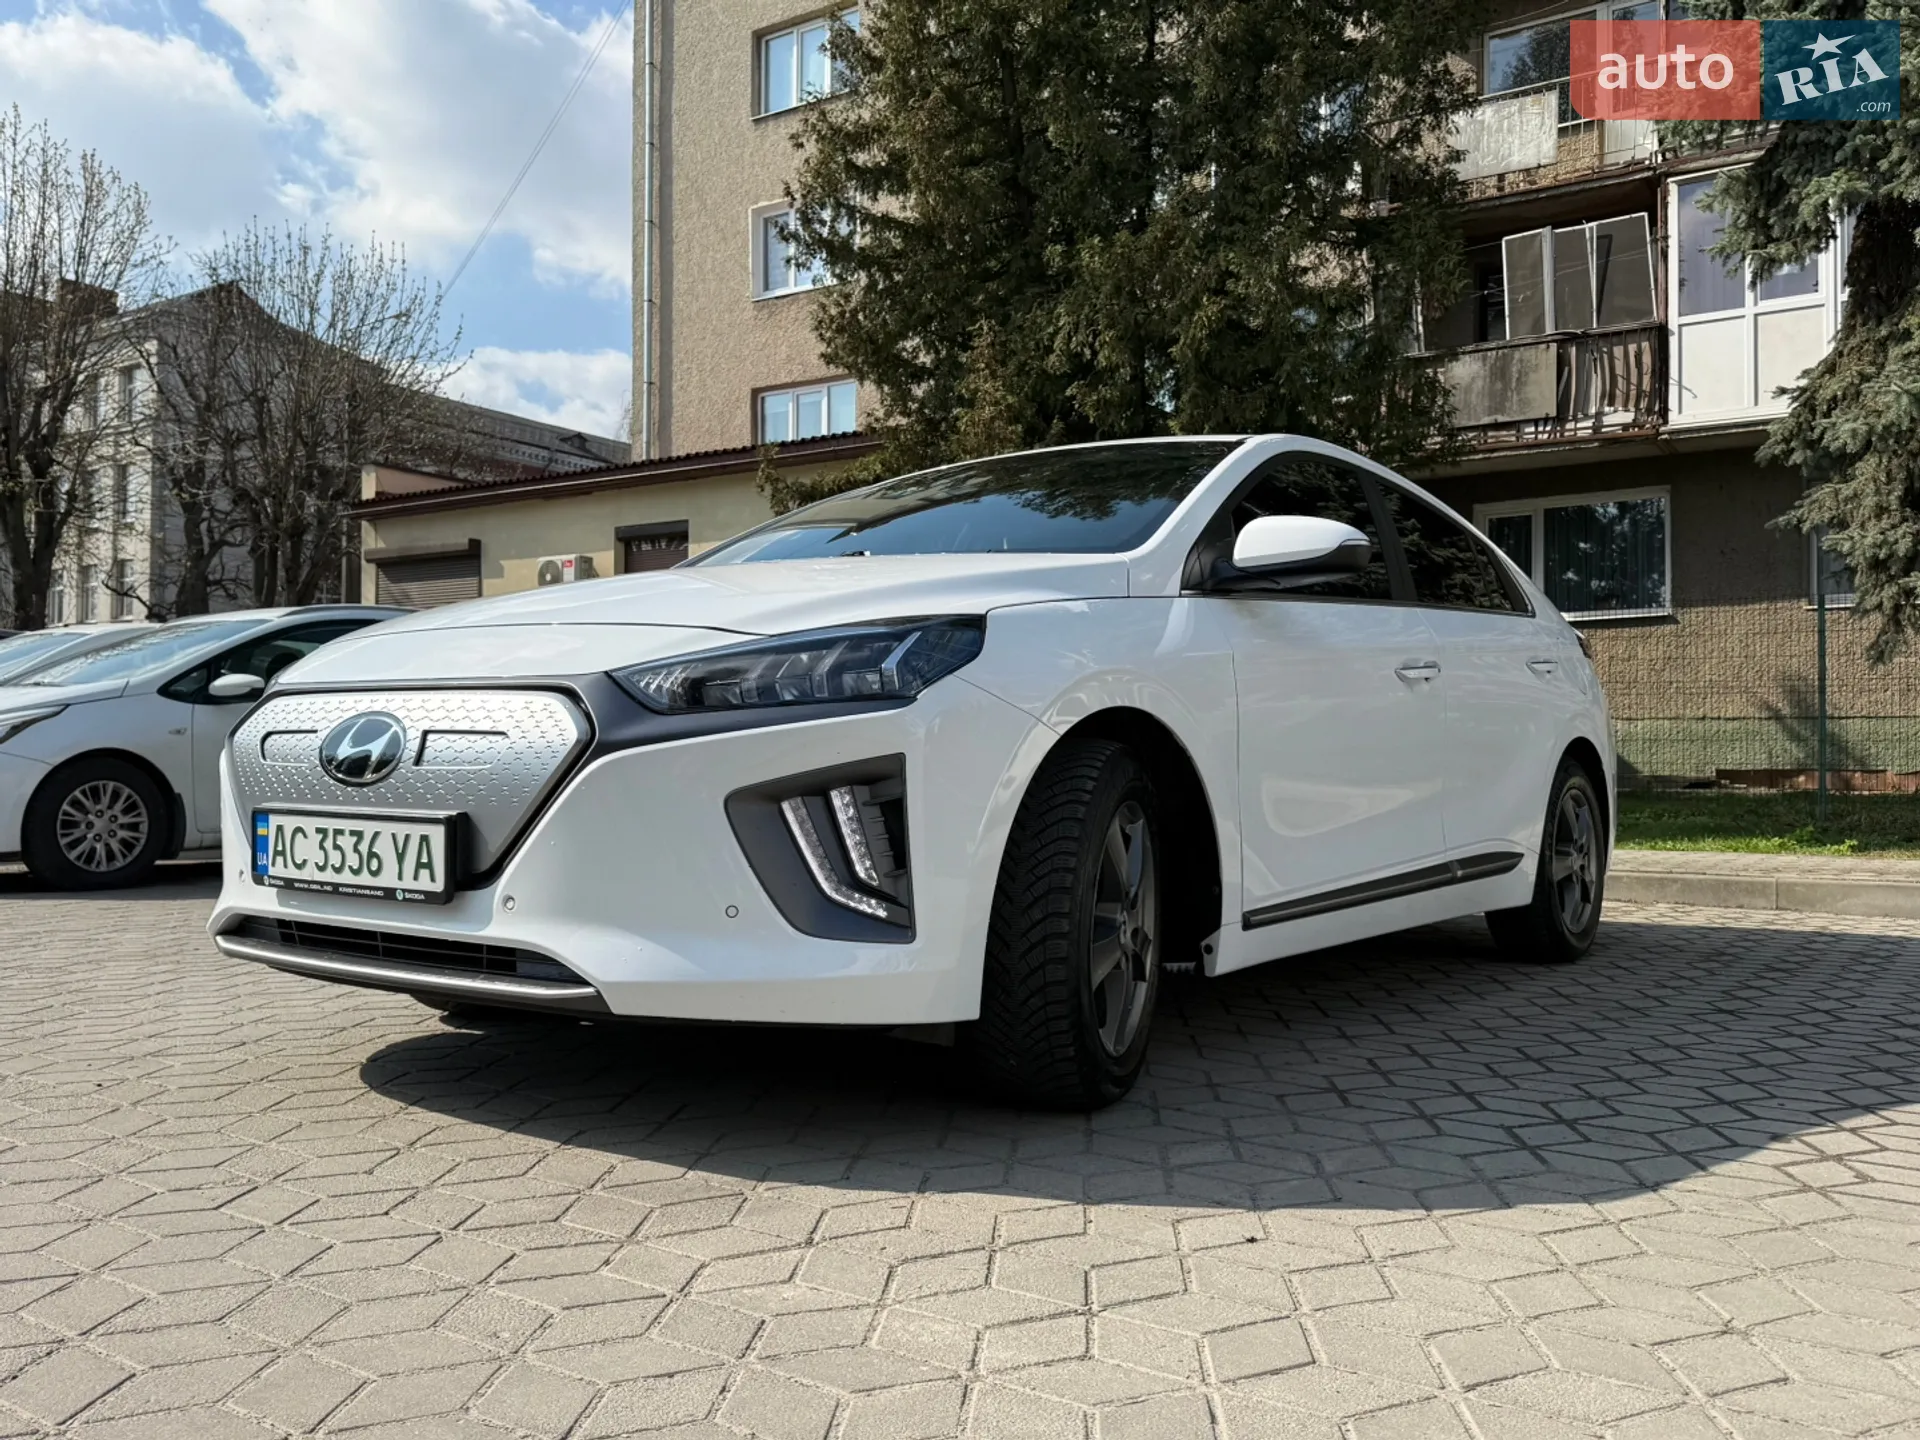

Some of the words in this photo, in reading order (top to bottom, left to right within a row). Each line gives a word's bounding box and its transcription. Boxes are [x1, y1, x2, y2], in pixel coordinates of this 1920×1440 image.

[257, 851, 268, 866] UA
[270, 823, 309, 871] AC
[314, 826, 383, 878] 3536
[391, 831, 437, 884] YA
